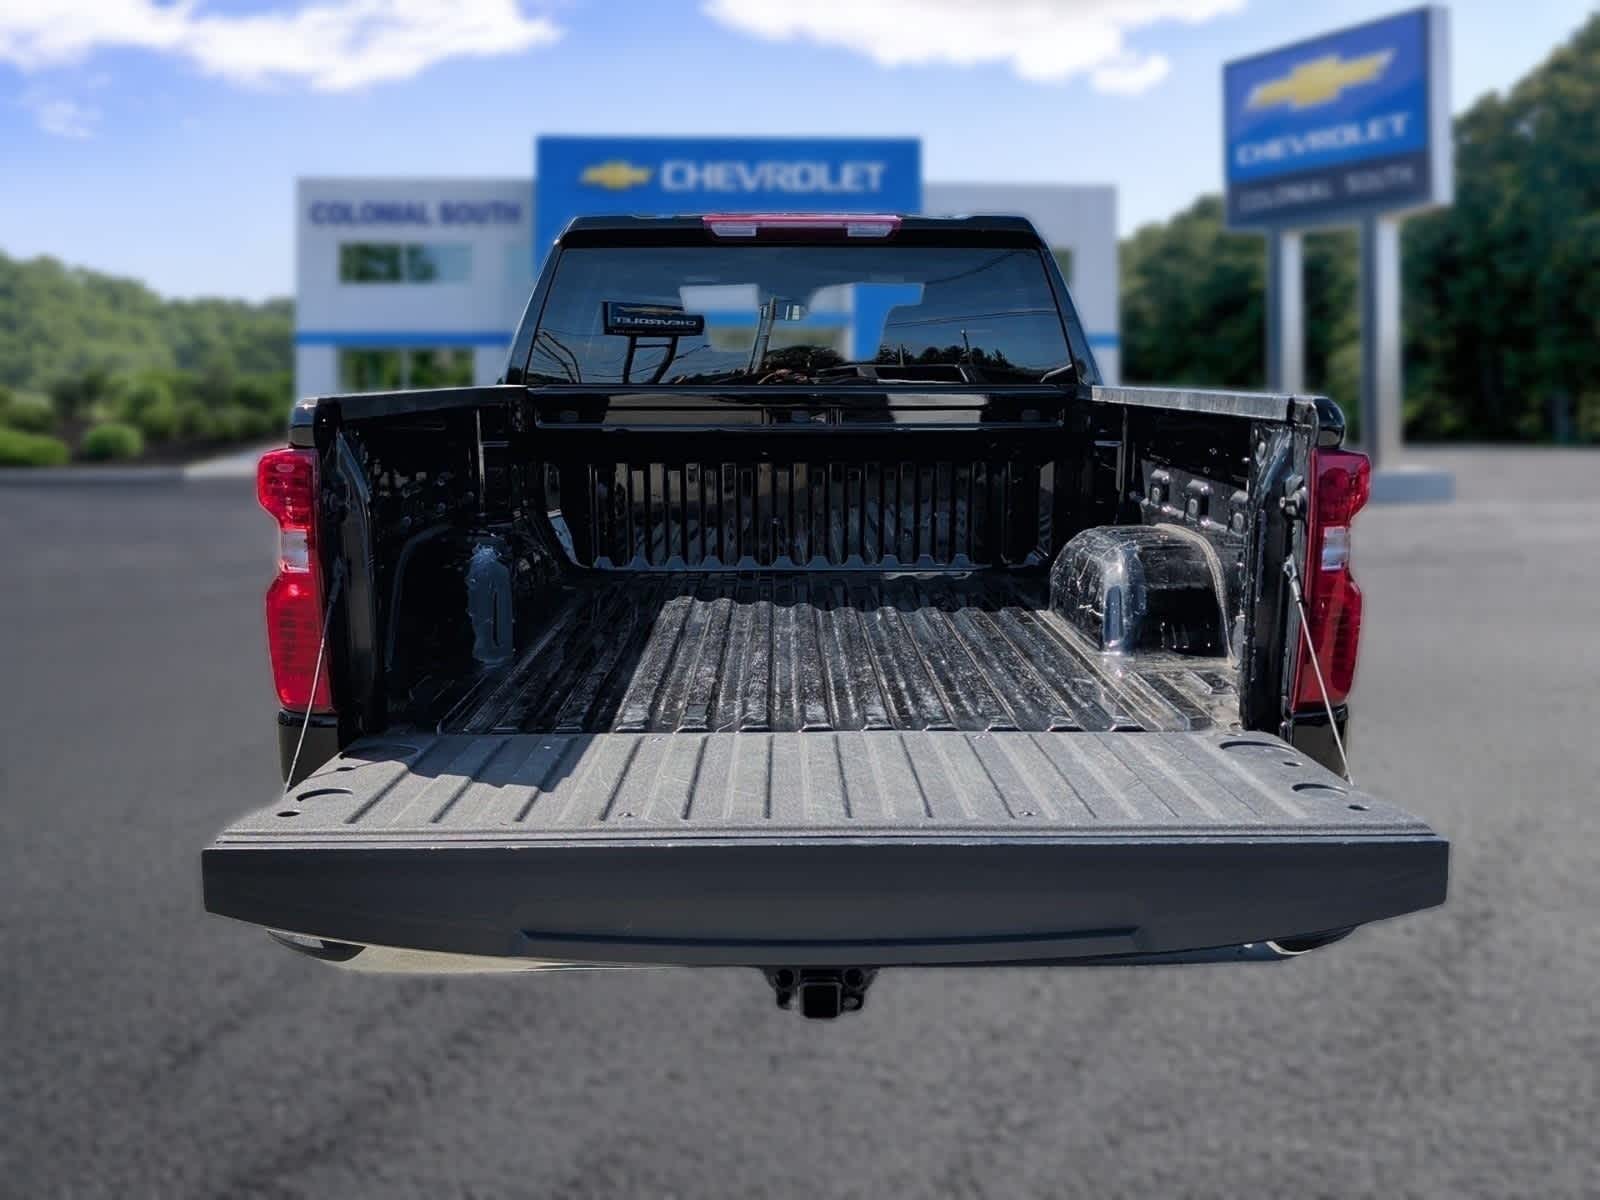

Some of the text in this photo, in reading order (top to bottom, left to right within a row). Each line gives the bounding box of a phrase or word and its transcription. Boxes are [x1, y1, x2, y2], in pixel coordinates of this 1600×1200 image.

[1236, 112, 1410, 166] CHEVROLET
[661, 161, 885, 192] CHEVROLET
[309, 202, 523, 226] COLONIAL SOUTH
